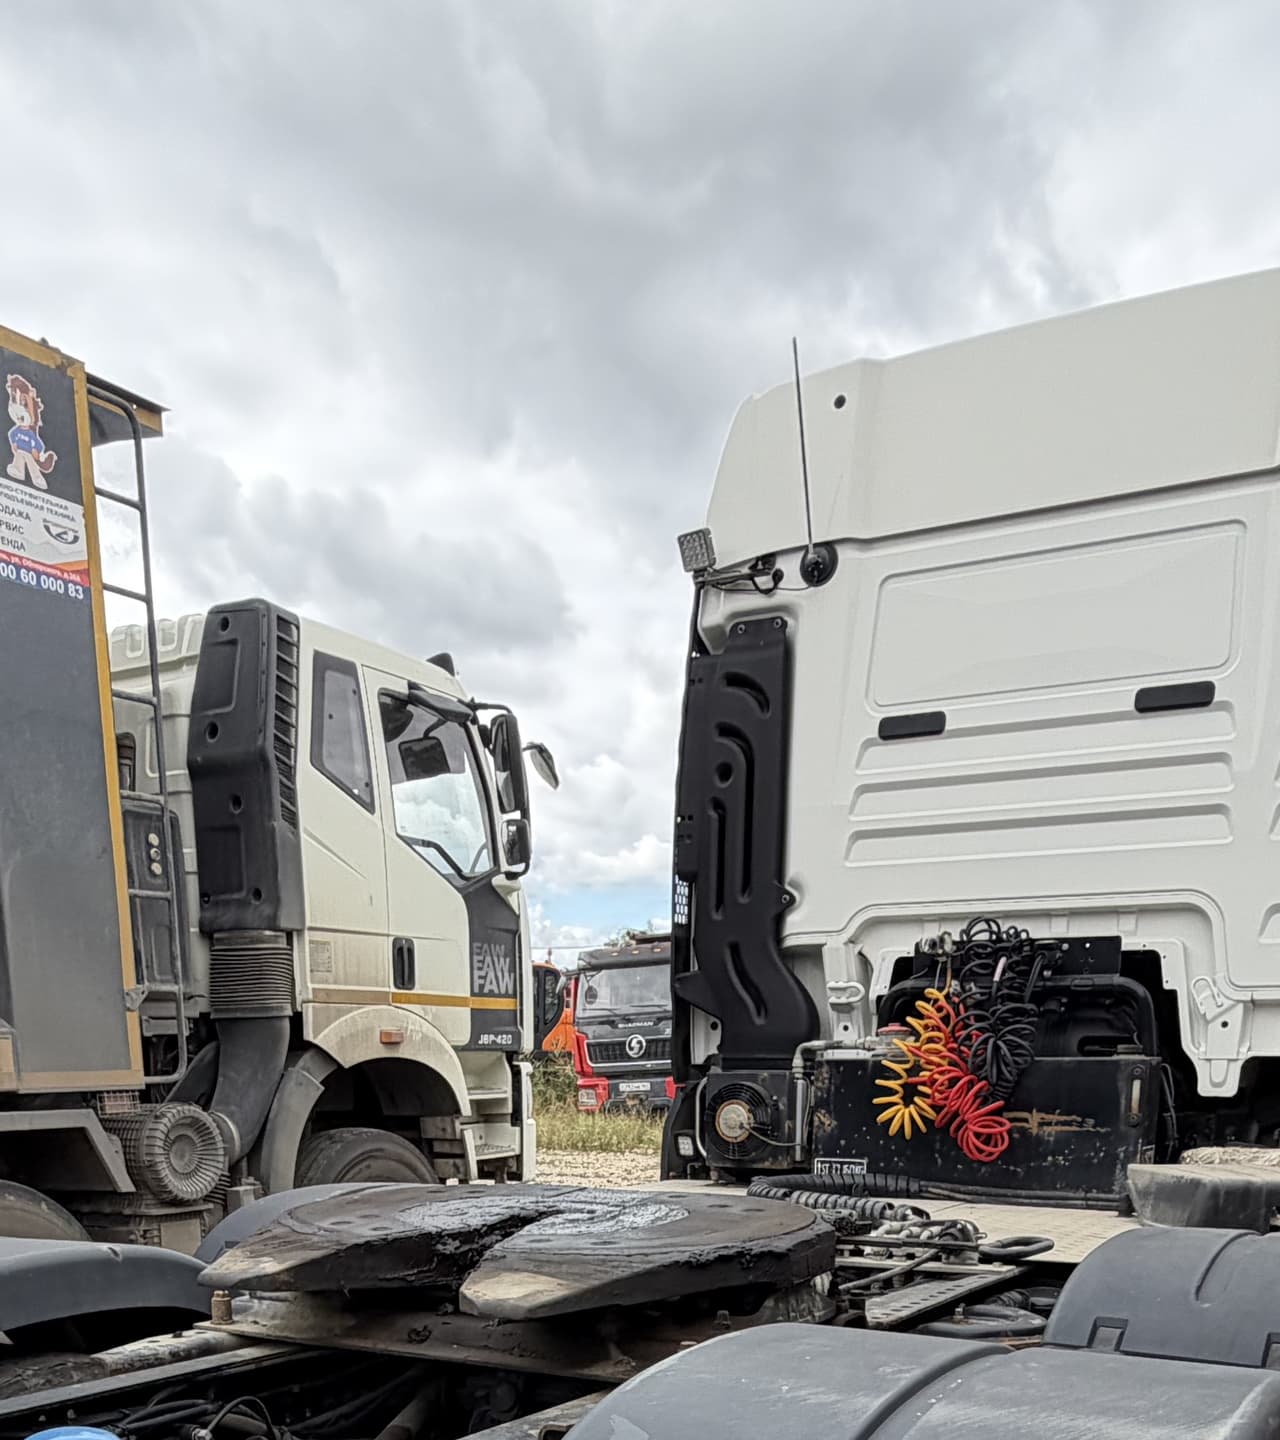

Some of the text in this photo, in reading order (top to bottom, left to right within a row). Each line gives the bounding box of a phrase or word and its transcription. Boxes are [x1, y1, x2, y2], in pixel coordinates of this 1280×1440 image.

[20, 569, 37, 585] 60
[40, 575, 64, 594] 000
[67, 582, 84, 600] 83
[473, 970, 514, 994] FAW
